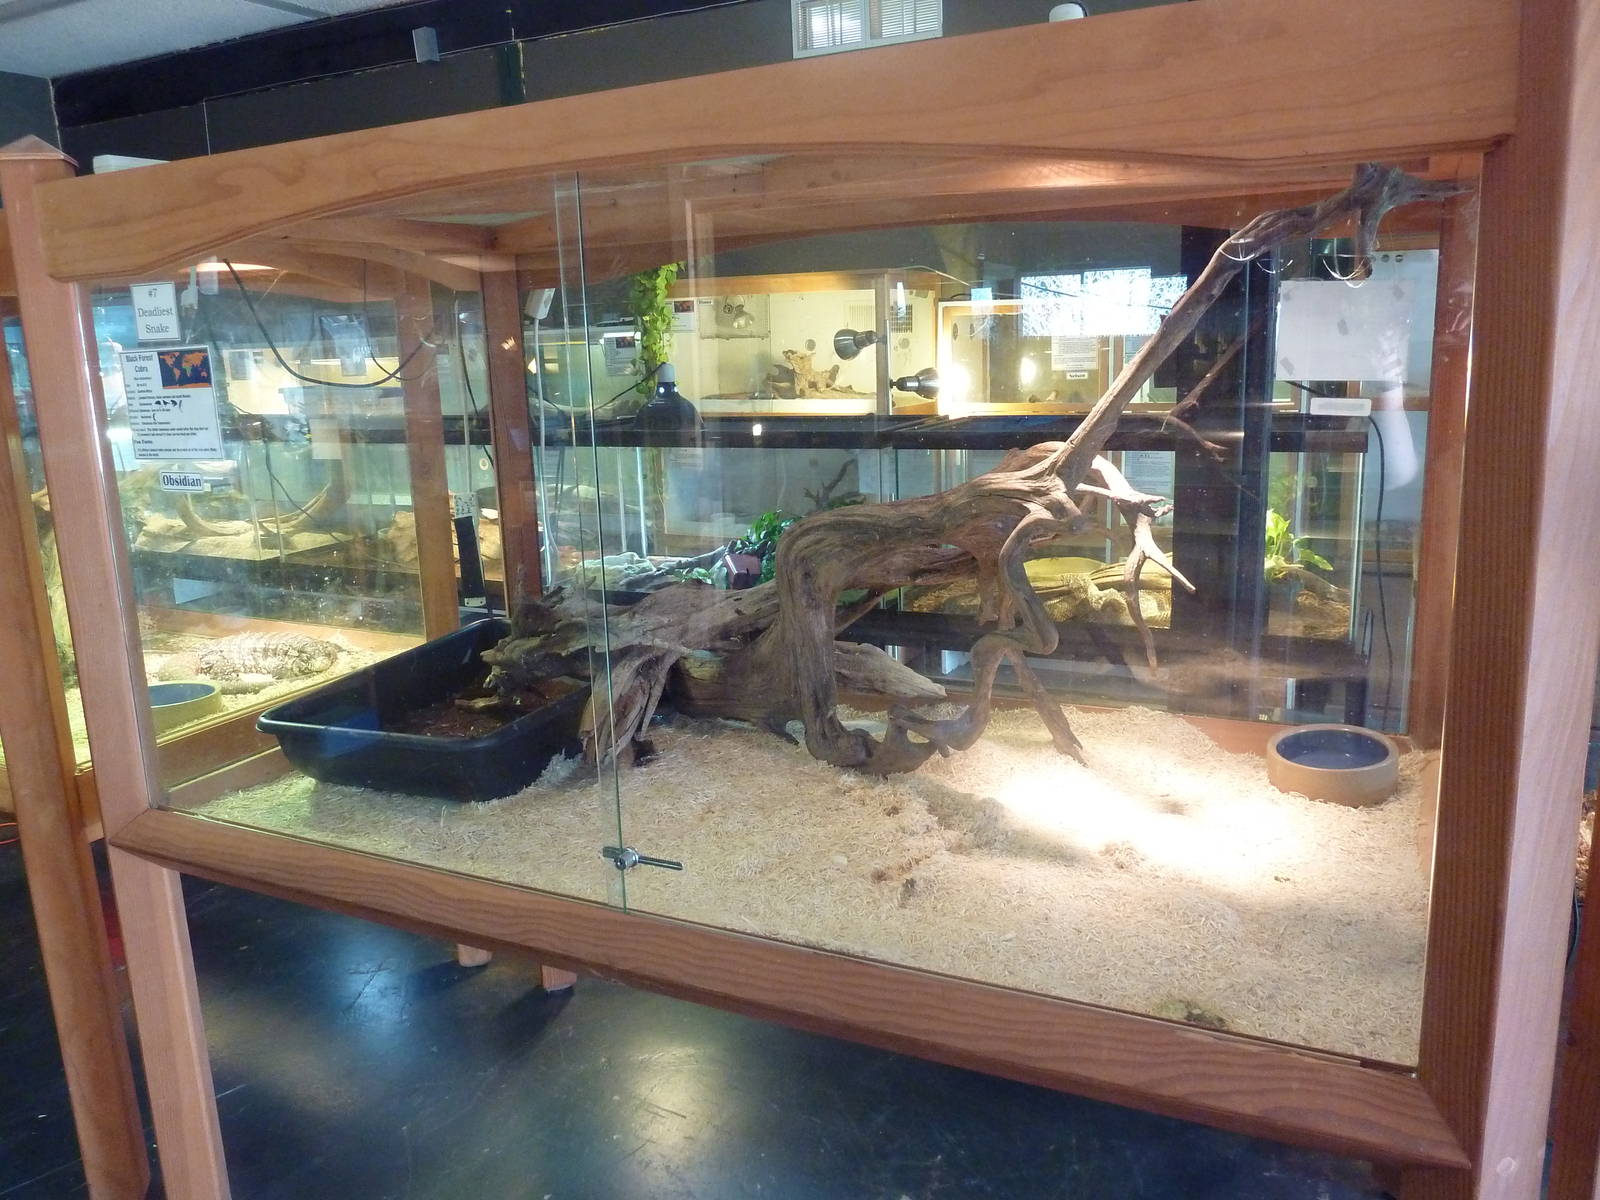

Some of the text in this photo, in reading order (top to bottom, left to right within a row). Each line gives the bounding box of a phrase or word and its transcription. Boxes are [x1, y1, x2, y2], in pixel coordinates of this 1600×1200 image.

[137, 307, 173, 318] Deadliest
[145, 324, 170, 334] Snake
[162, 474, 202, 487] Obsidian
